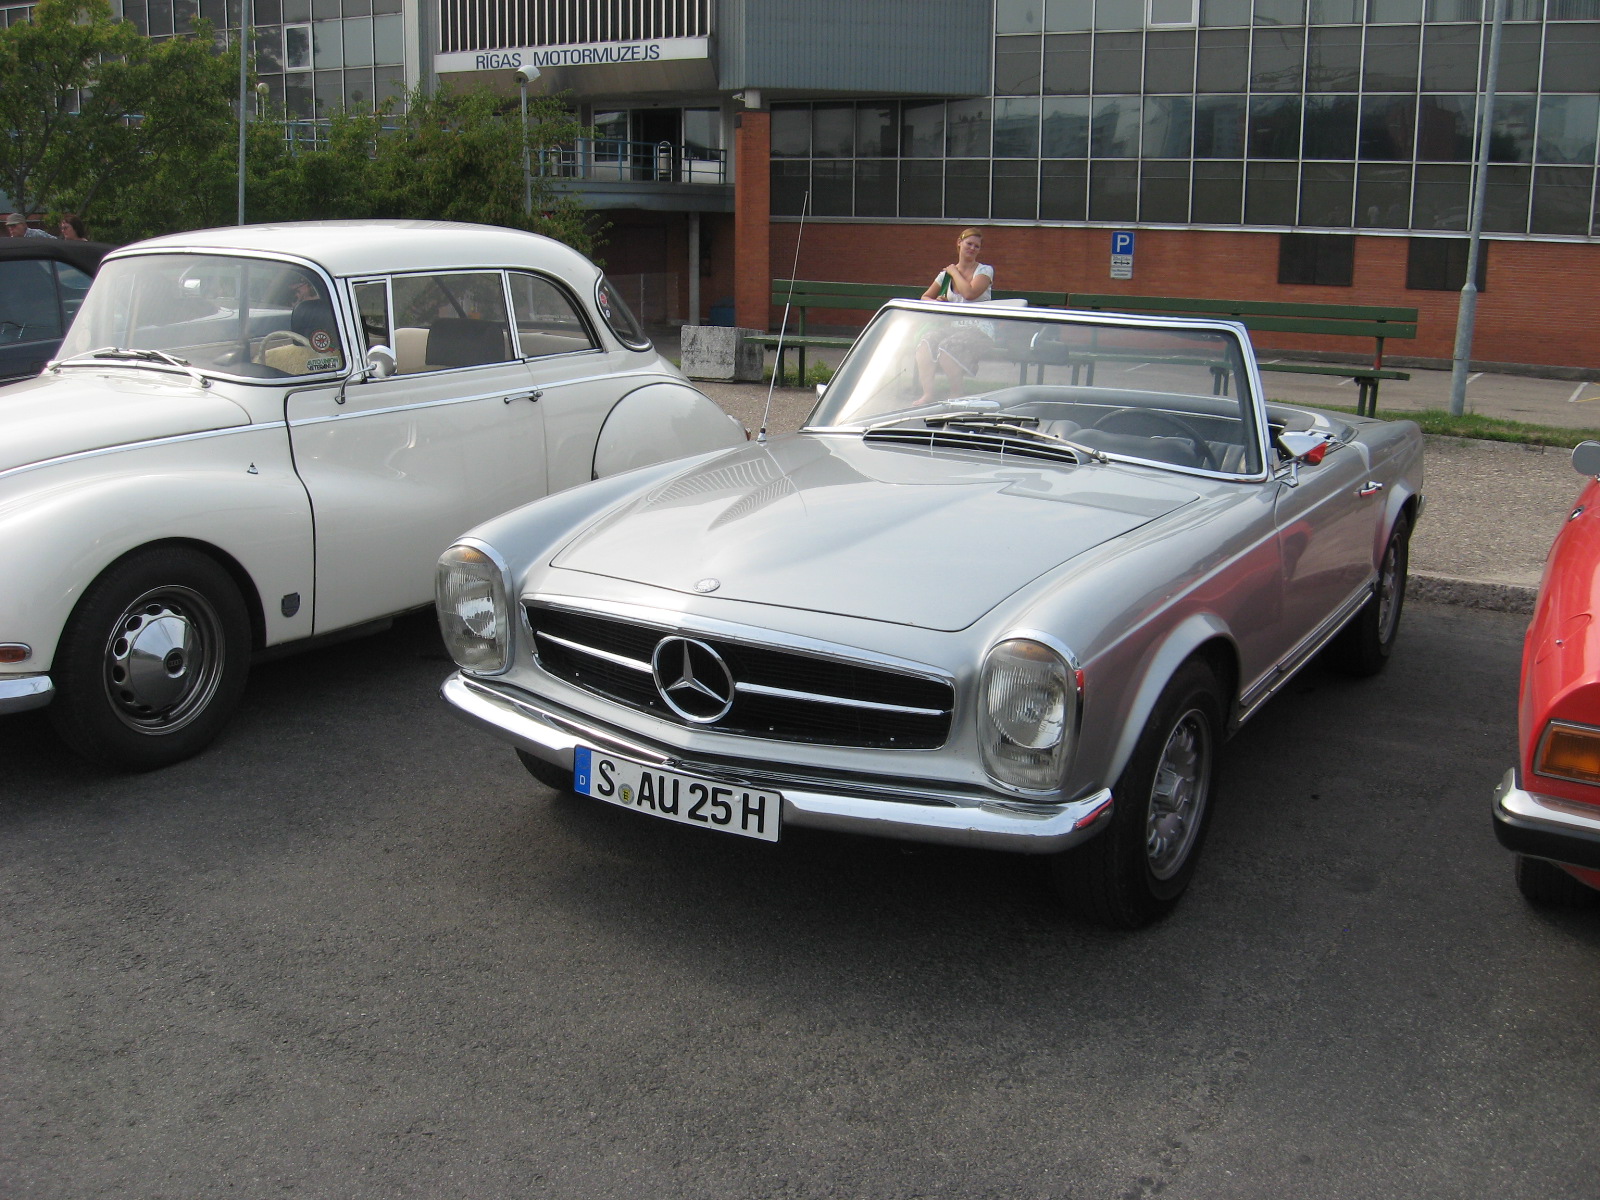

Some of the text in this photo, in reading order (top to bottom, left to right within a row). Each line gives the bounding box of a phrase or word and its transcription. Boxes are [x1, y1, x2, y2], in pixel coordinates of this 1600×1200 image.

[475, 44, 660, 70] RĪGAS MOTORMUZEJS
[1116, 234, 1130, 253] P
[579, 774, 586, 786] D
[597, 759, 616, 797] S
